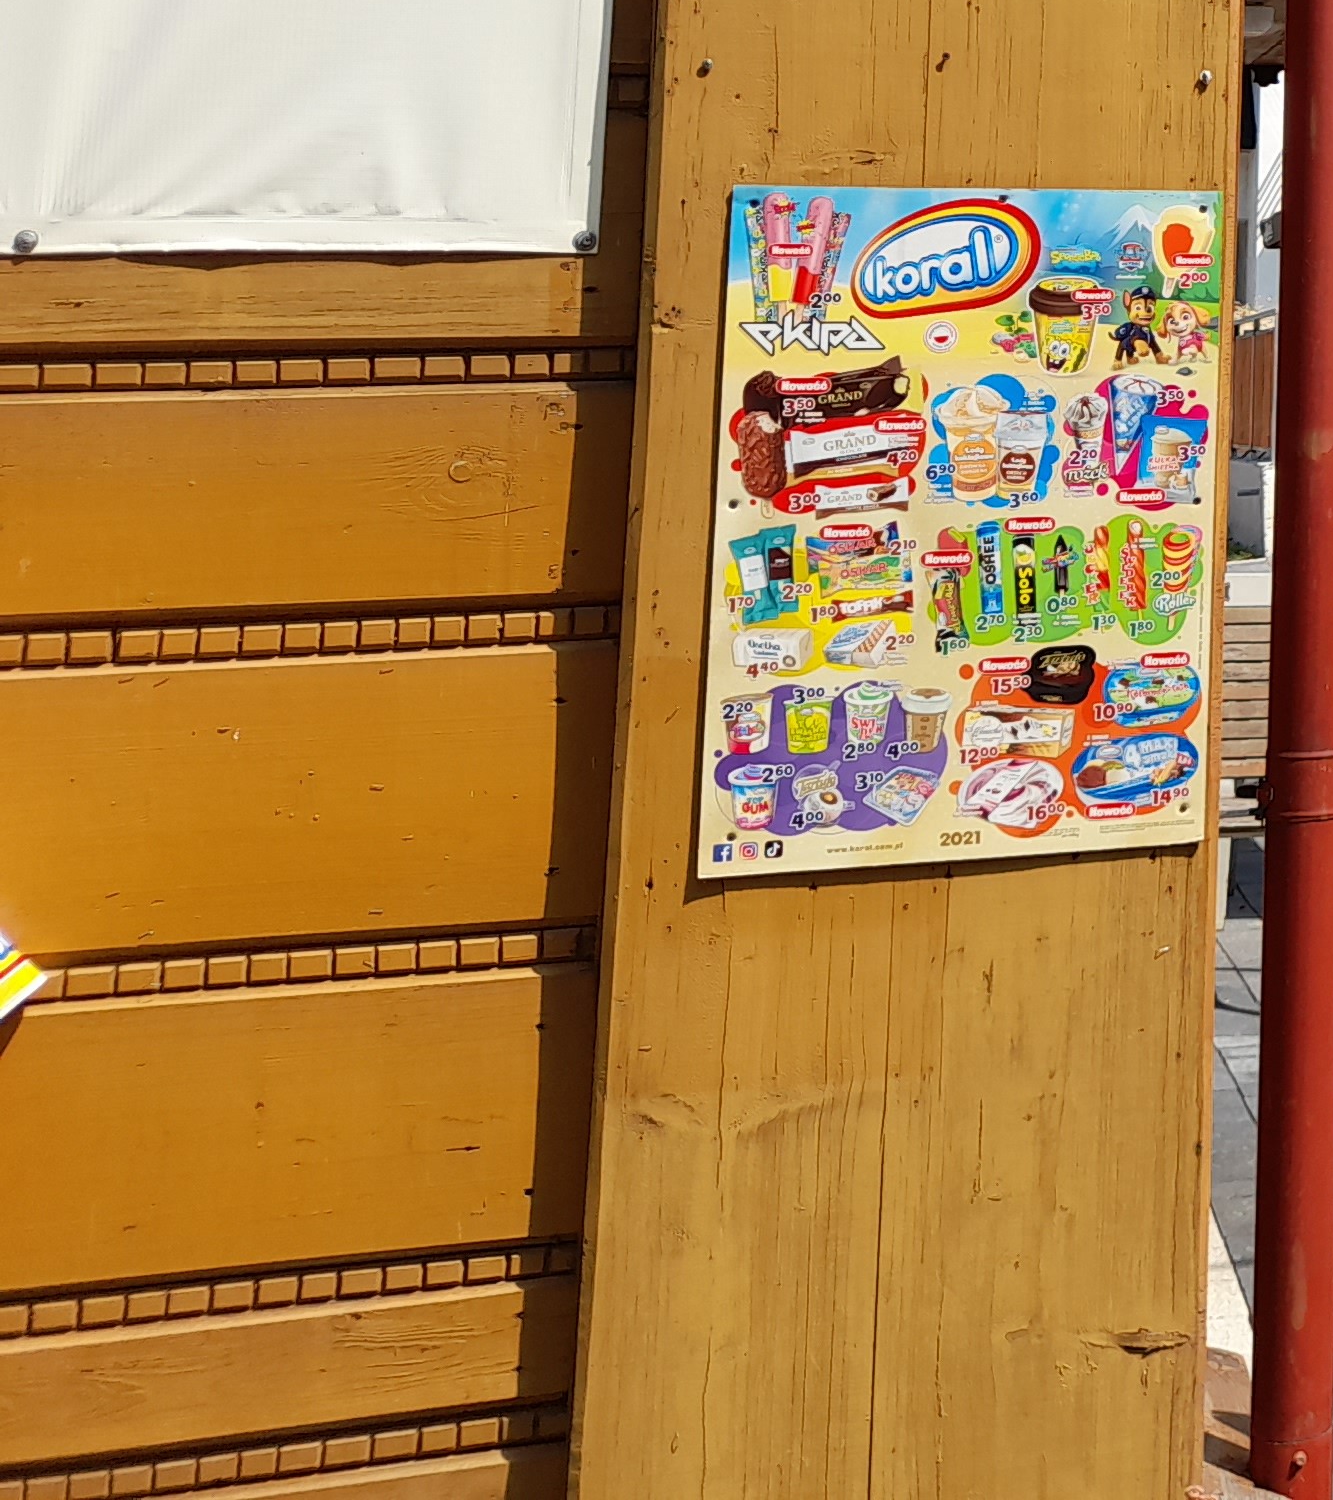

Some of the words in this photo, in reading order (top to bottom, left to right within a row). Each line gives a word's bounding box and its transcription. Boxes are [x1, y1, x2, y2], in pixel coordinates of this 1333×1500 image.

[875, 230, 991, 298] koral
[781, 380, 829, 391] Nowość
[818, 390, 863, 404] GRAND
[878, 420, 924, 431] Nowość
[823, 434, 877, 452] GRAND
[823, 527, 870, 538] Nowość
[1008, 520, 1052, 531] Nowość
[924, 553, 970, 564] Nowość
[983, 536, 996, 585] OSHEE
[1019, 567, 1033, 605] Solo
[1155, 593, 1197, 613] Roller
[1144, 655, 1188, 666] Nowość
[940, 831, 981, 846] 2021
